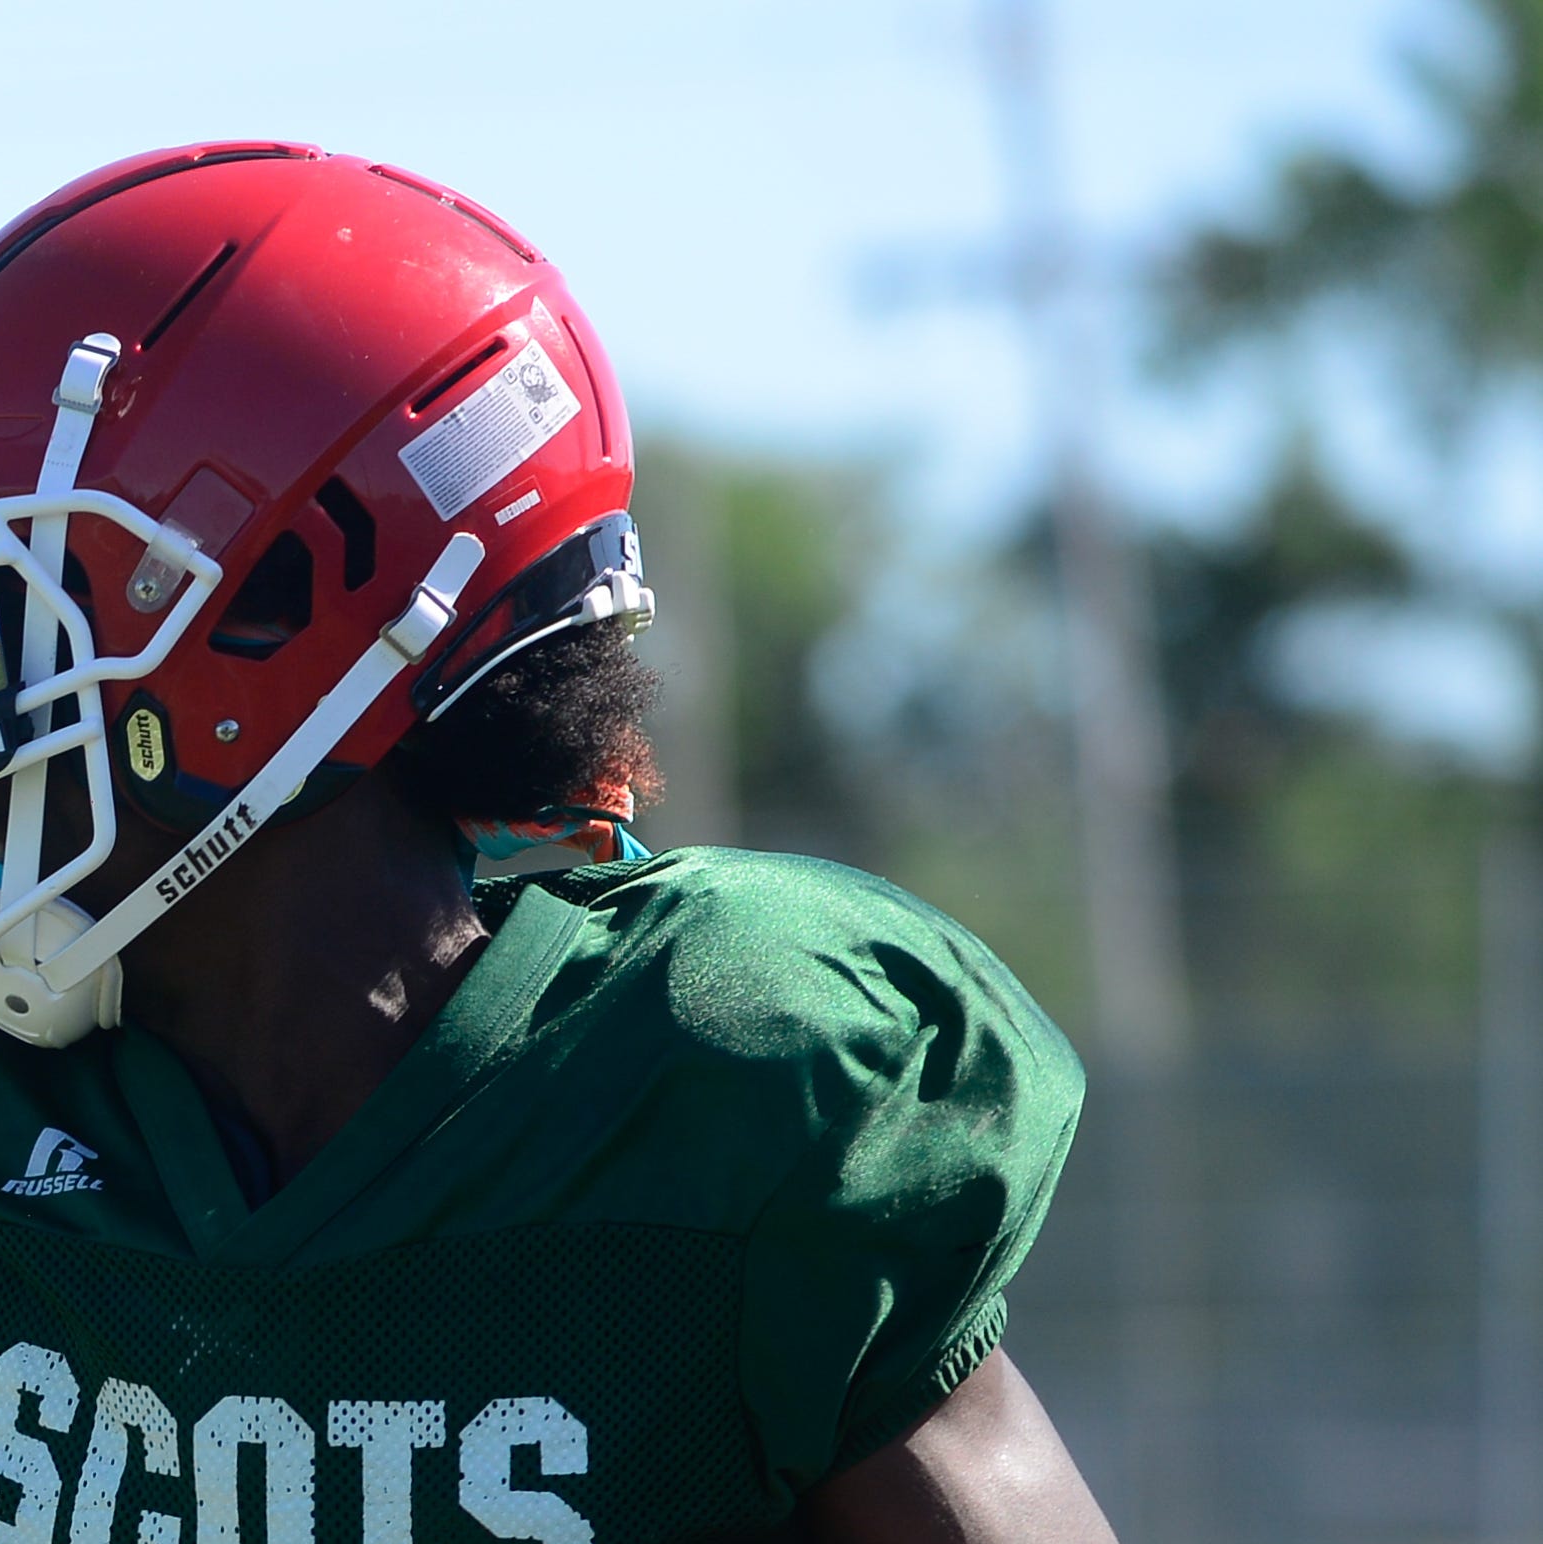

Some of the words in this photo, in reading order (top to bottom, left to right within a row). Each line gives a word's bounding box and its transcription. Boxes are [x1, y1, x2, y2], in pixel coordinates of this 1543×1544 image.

[137, 713, 155, 770] schutt
[156, 801, 257, 904] schutt
[0, 1173, 103, 1198] RUSSELL
